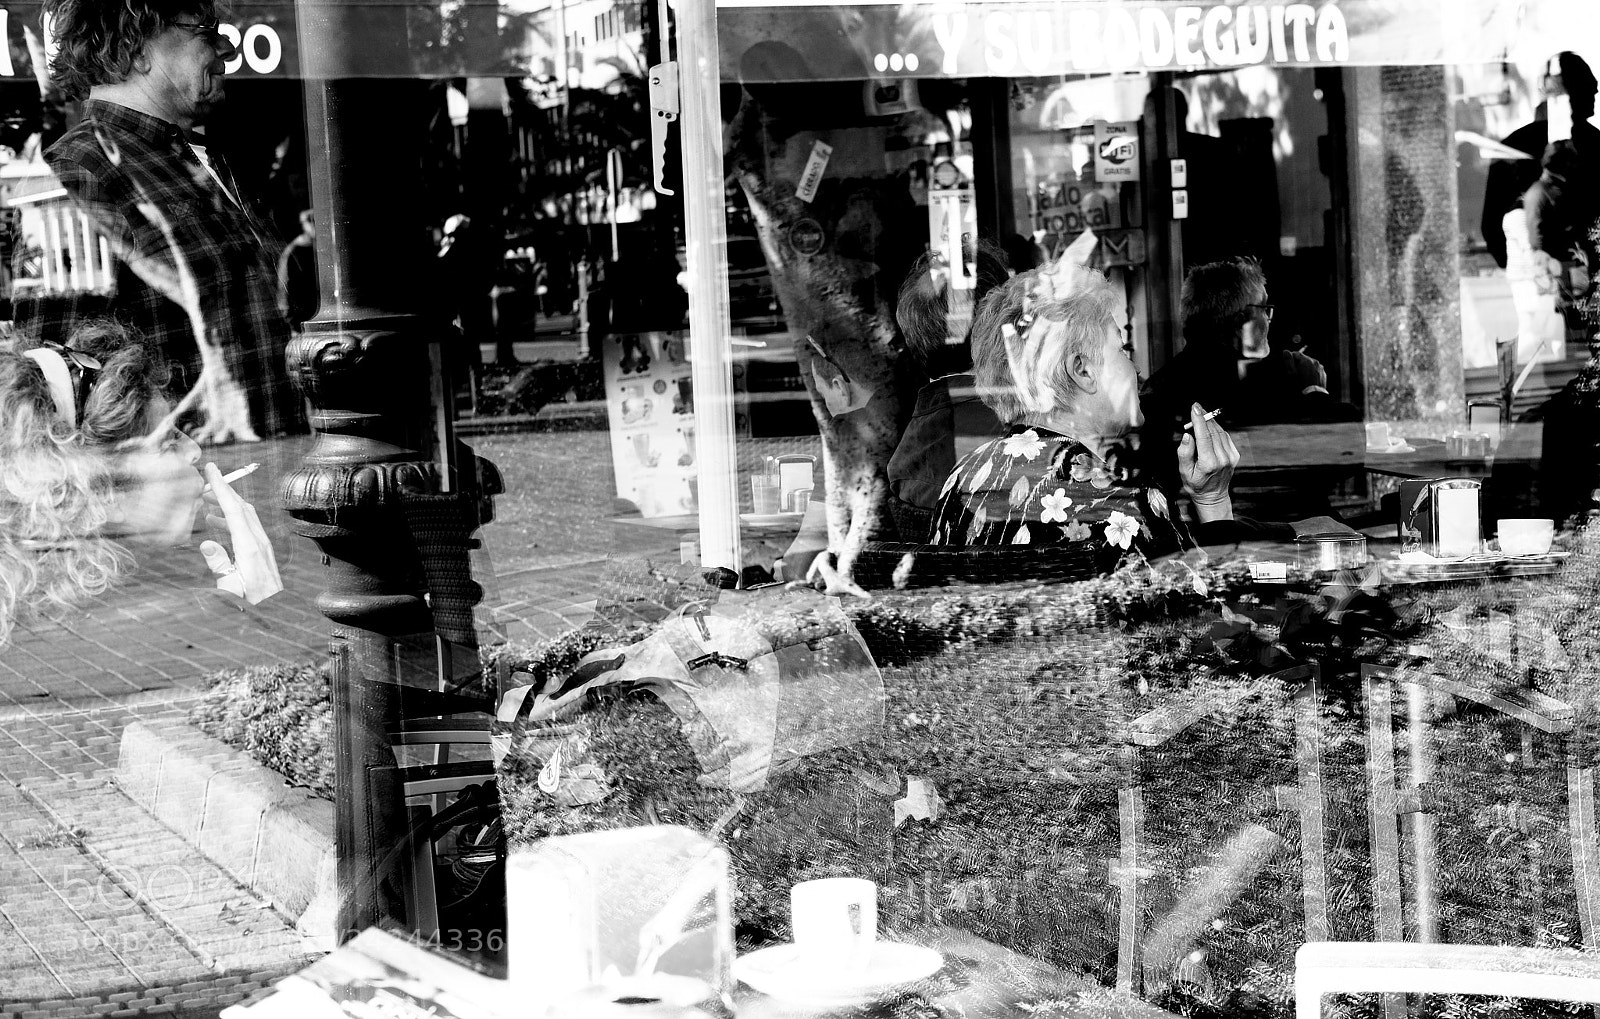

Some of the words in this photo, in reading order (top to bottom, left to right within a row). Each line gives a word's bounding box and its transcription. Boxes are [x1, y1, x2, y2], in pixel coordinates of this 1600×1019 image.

[932, 13, 968, 74] Y
[985, 11, 1052, 73] SU
[1069, 5, 1349, 71] BODEGUITA
